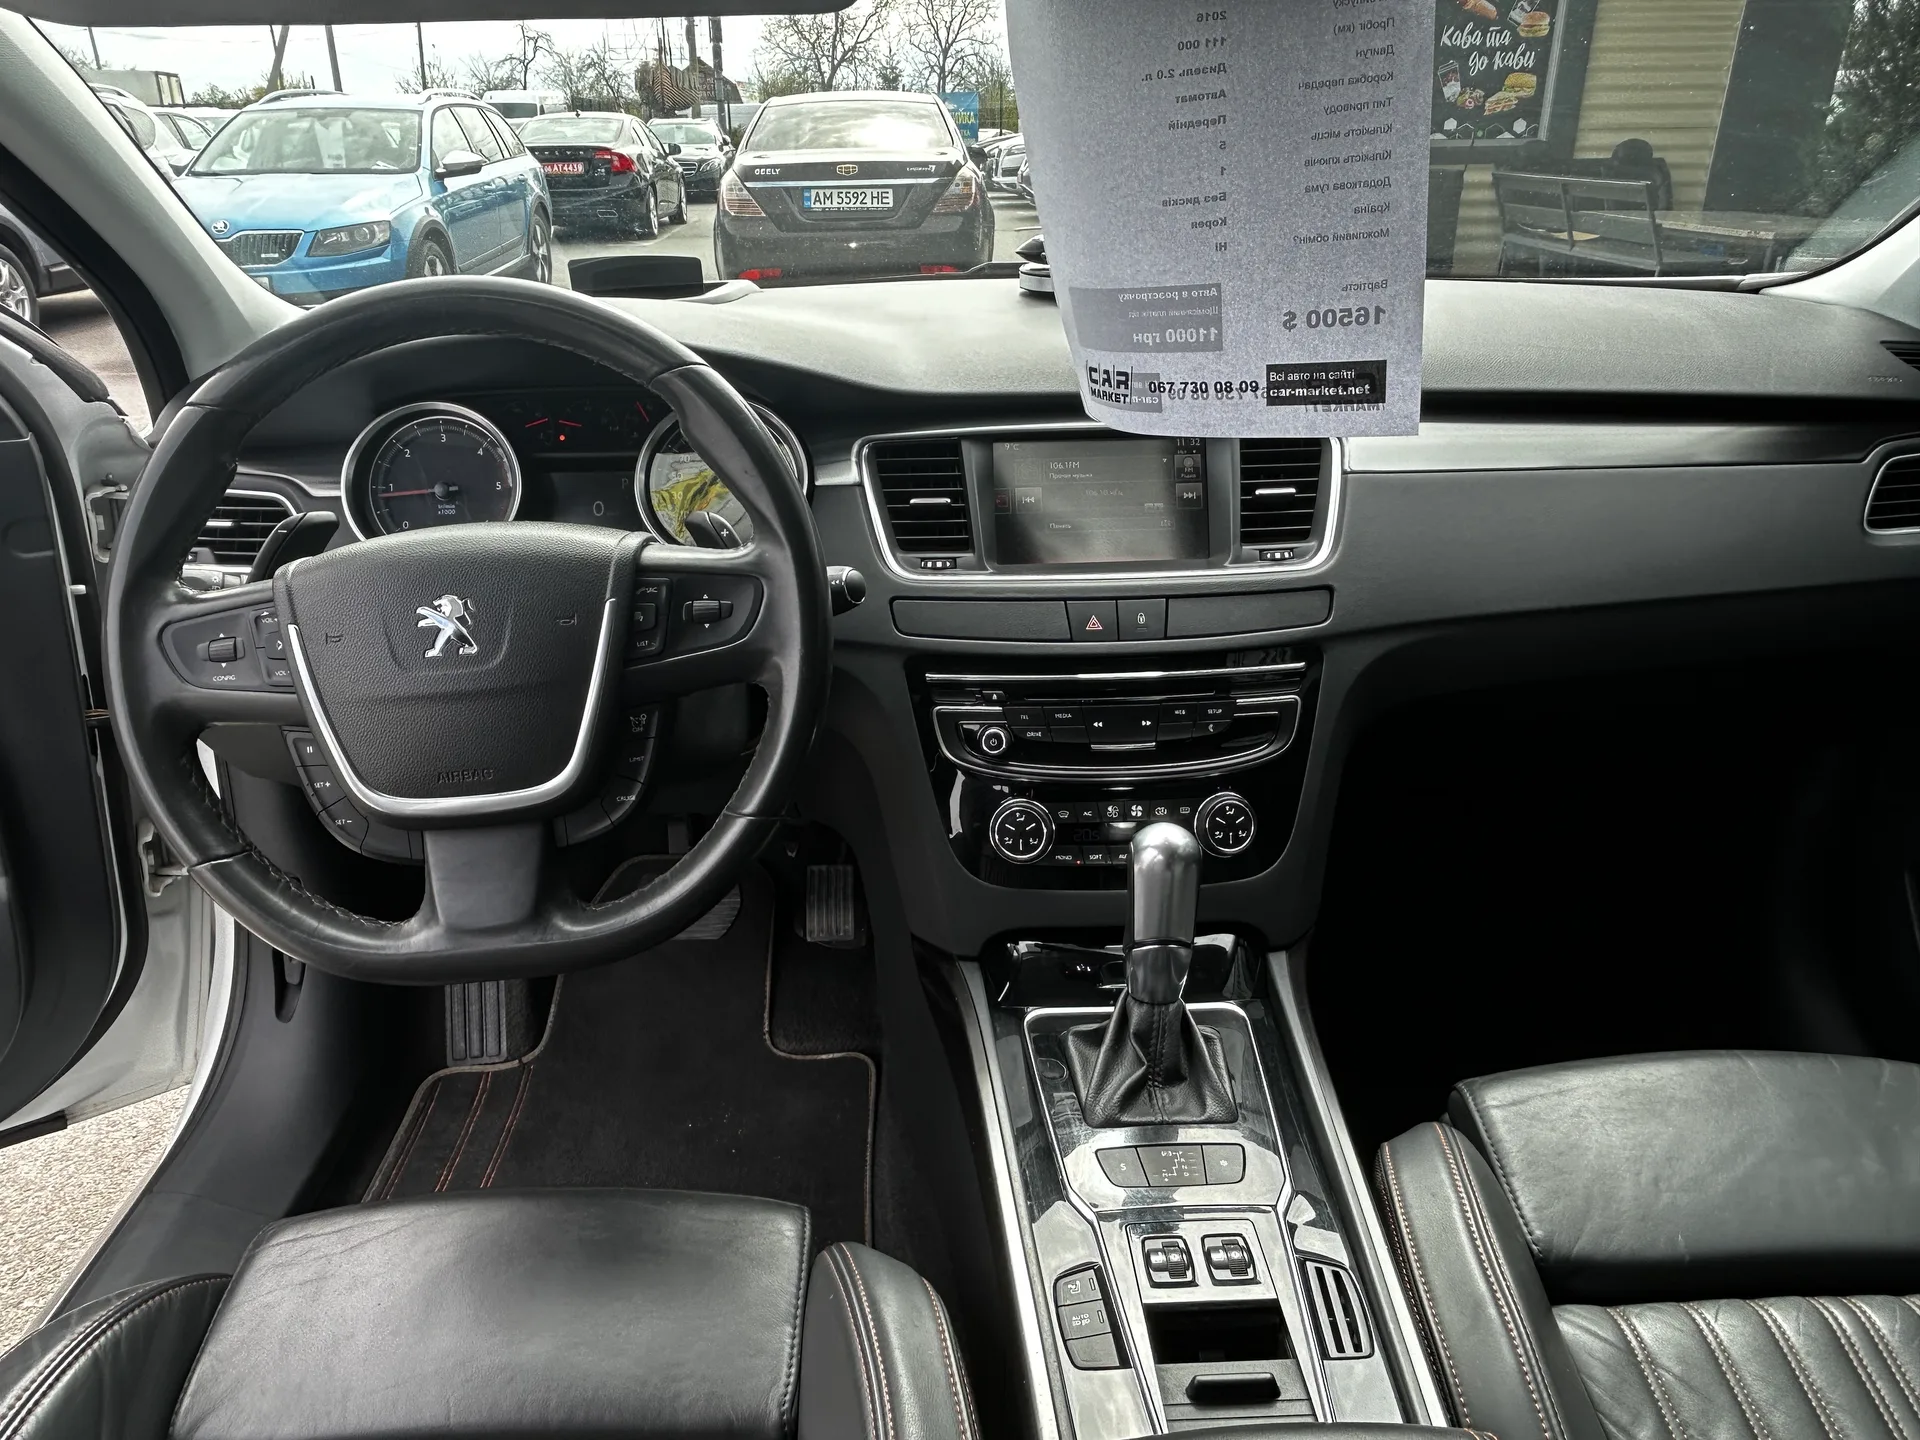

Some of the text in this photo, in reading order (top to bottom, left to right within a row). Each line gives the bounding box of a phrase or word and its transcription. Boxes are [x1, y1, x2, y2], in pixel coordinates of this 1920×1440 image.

[1440, 22, 1483, 49] Кава
[1468, 43, 1536, 76] до кави
[813, 191, 833, 205] AM
[837, 191, 868, 205] 5592
[871, 191, 890, 205] HE
[1089, 366, 1130, 390] CAR
[1270, 371, 1285, 381] Всі
[1287, 372, 1310, 380] авто
[1328, 369, 1355, 379] сайті
[1149, 381, 1175, 393] 067
[1180, 381, 1208, 393] 730
[1214, 381, 1233, 393] 08
[1239, 380, 1259, 393] 09
[1270, 384, 1370, 398] car-market.net
[1090, 386, 1129, 404] MARKET
[440, 434, 446, 442] 3
[404, 449, 411, 457] 2
[477, 448, 483, 456] 4
[496, 482, 501, 490] 5
[403, 521, 409, 529] 0
